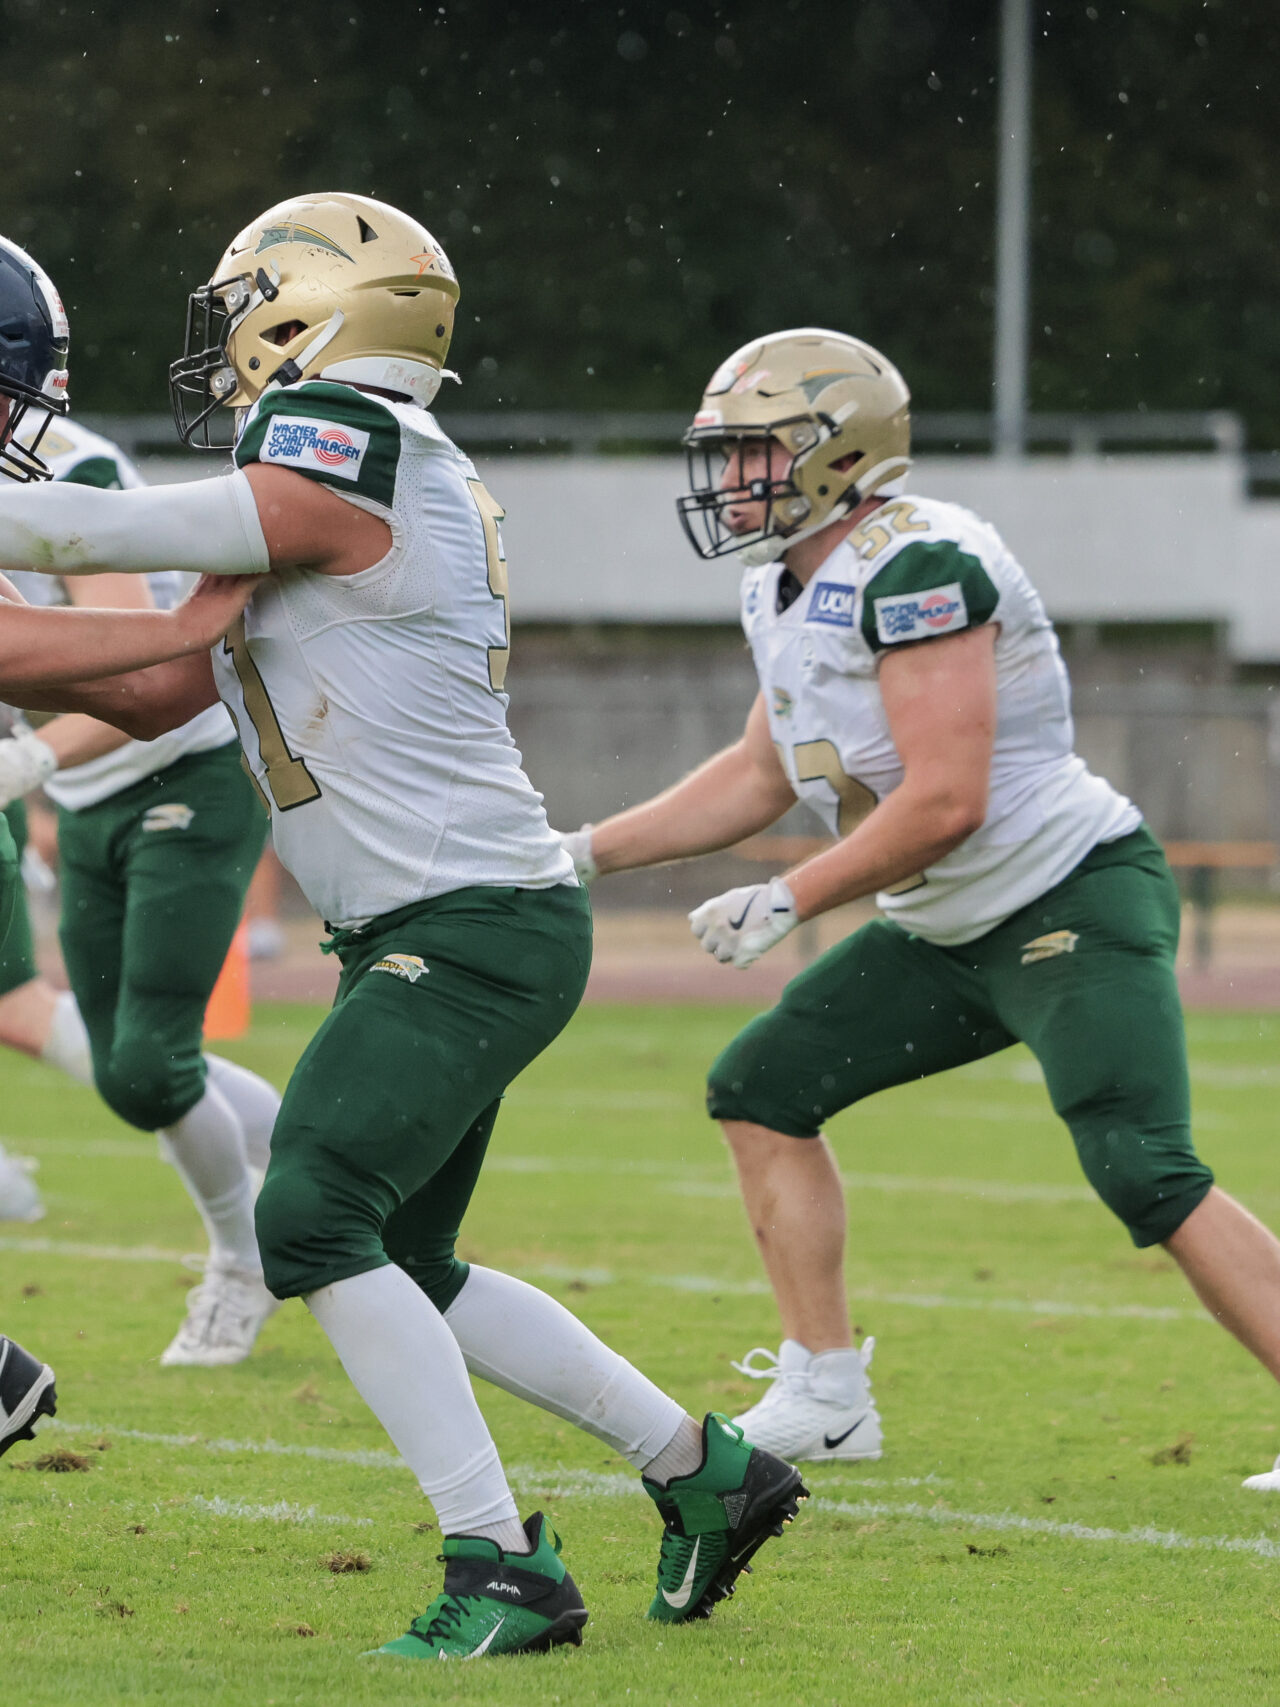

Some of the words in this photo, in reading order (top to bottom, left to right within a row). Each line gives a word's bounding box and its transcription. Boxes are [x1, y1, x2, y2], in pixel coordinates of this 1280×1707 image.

[272, 423, 319, 438] WAGNER
[268, 433, 361, 460] SCHALTANLAGEN
[268, 445, 304, 458] GMBH
[847, 502, 931, 561] 52
[486, 1581, 521, 1596] ALPHA
